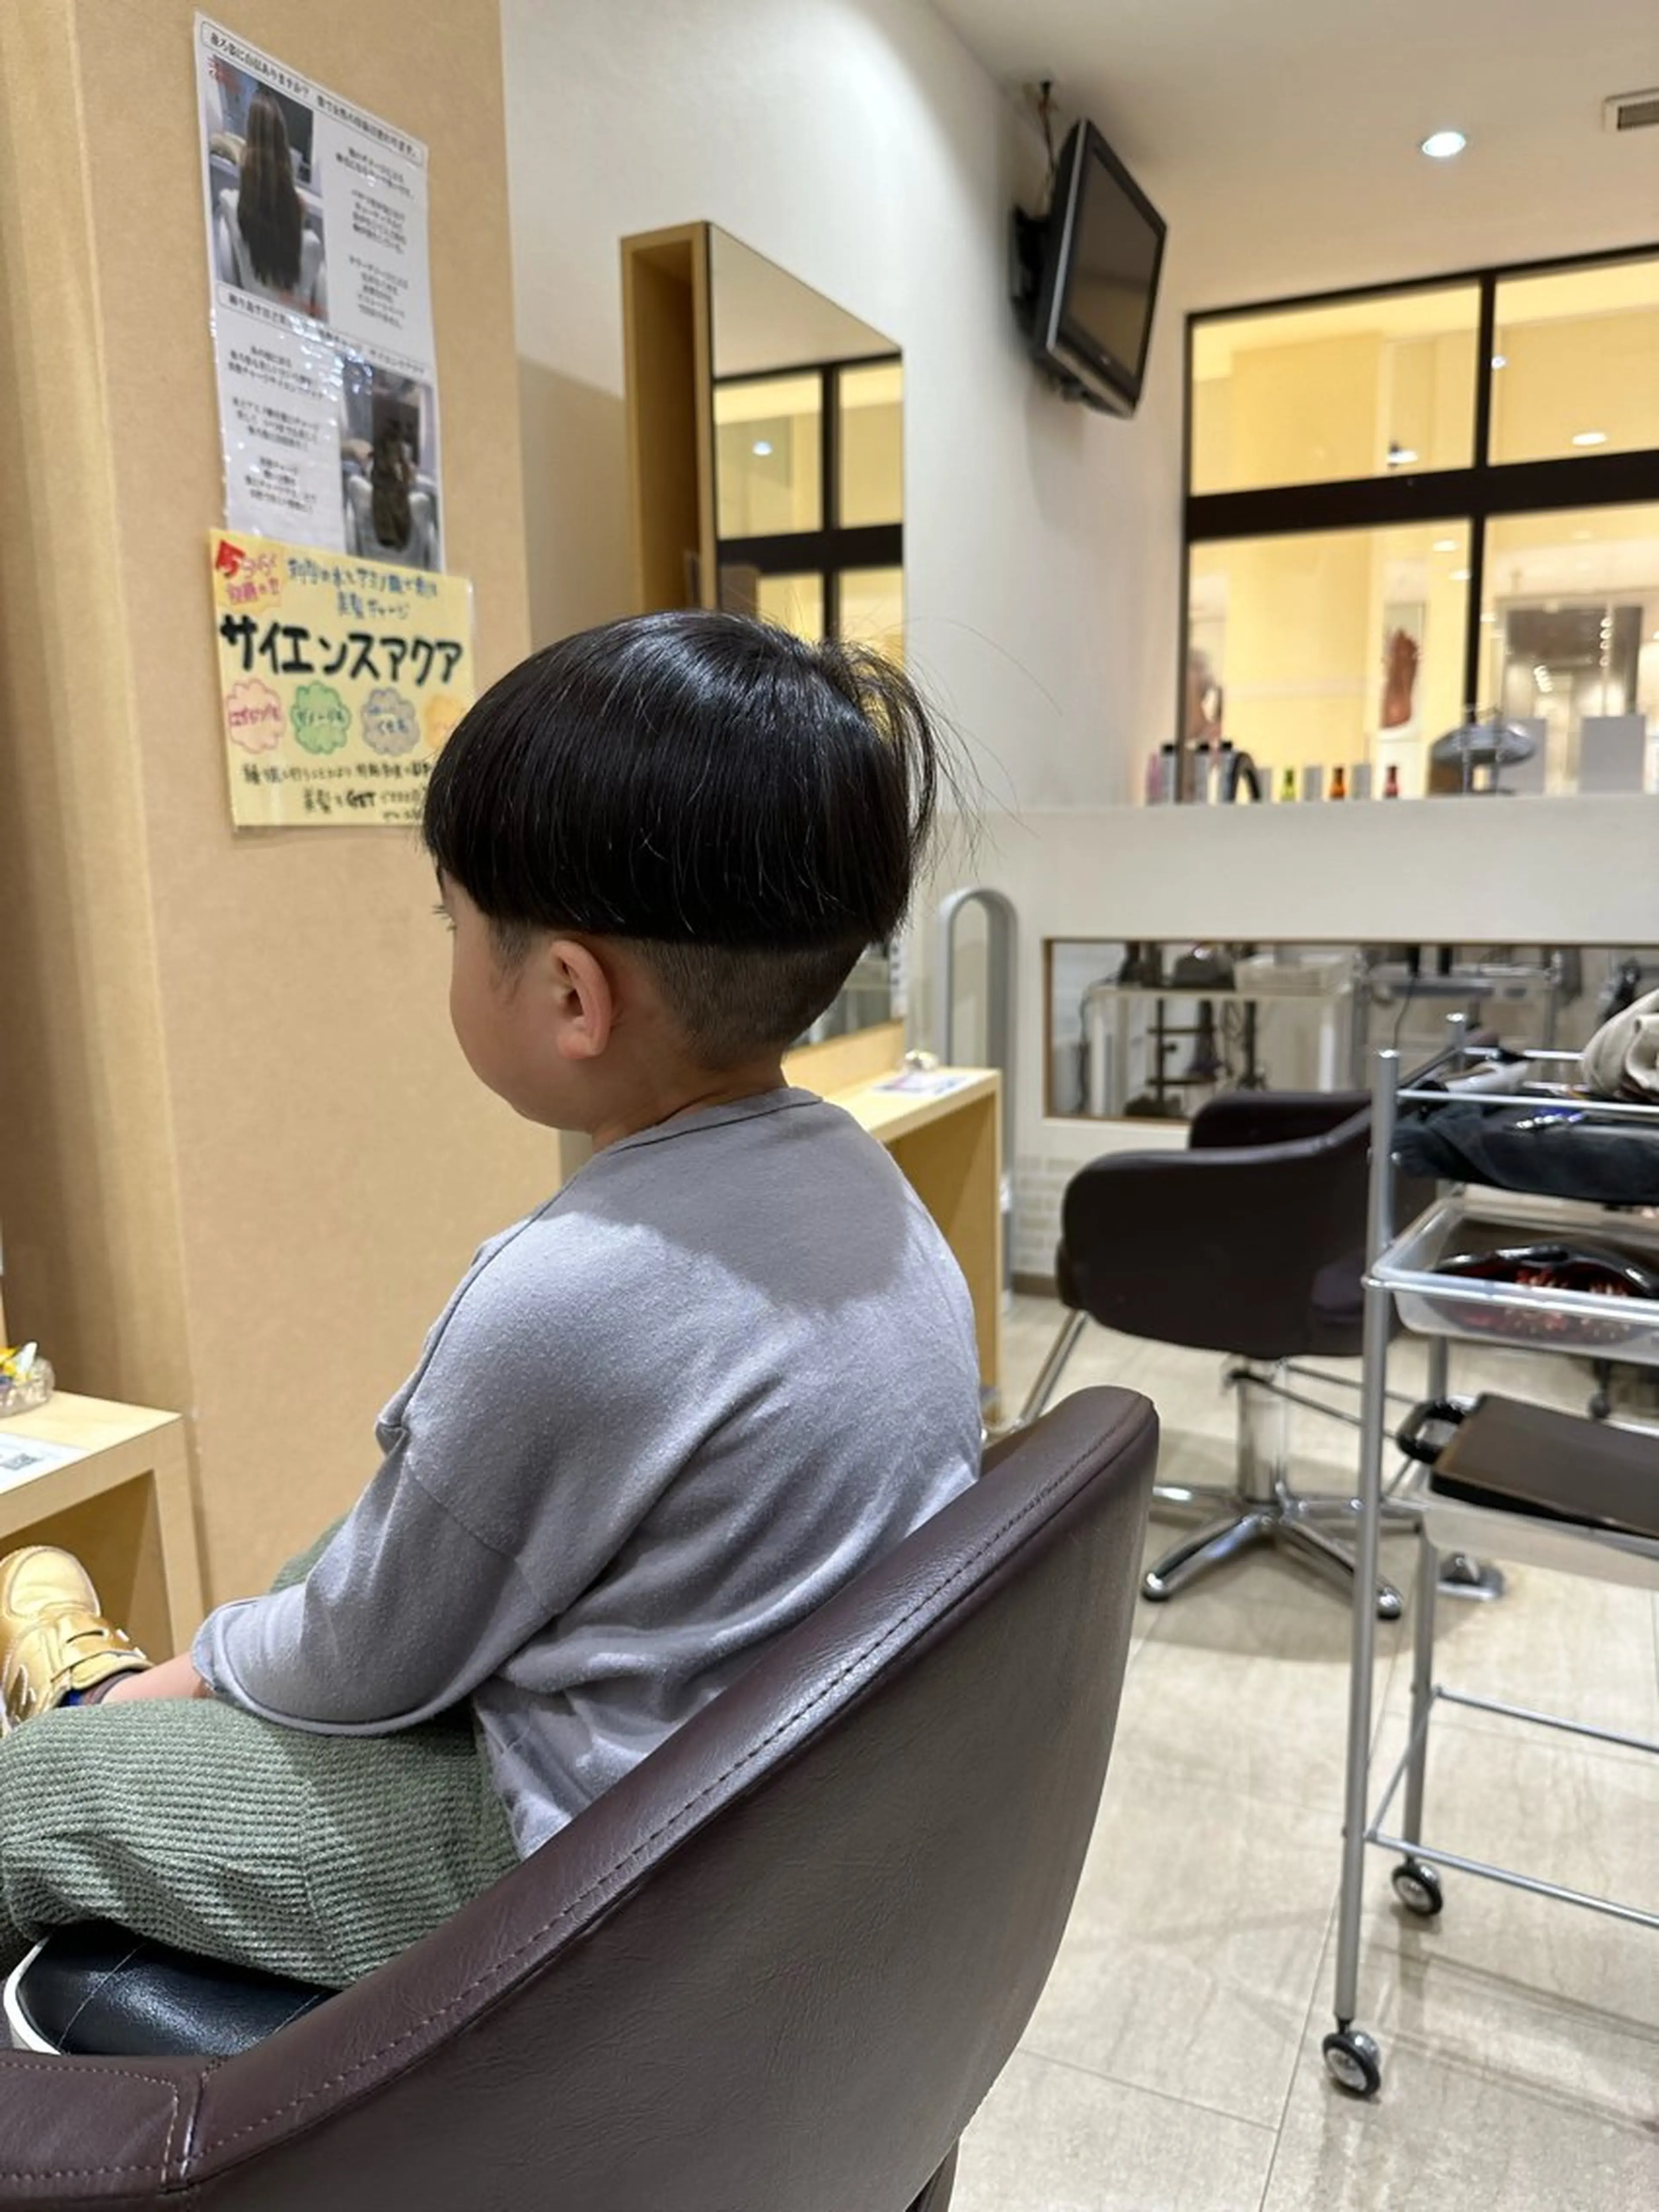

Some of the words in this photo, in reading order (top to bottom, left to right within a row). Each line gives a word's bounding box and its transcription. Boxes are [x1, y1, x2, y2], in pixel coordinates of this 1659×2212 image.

[220, 614, 463, 685] サイエンスアクア
